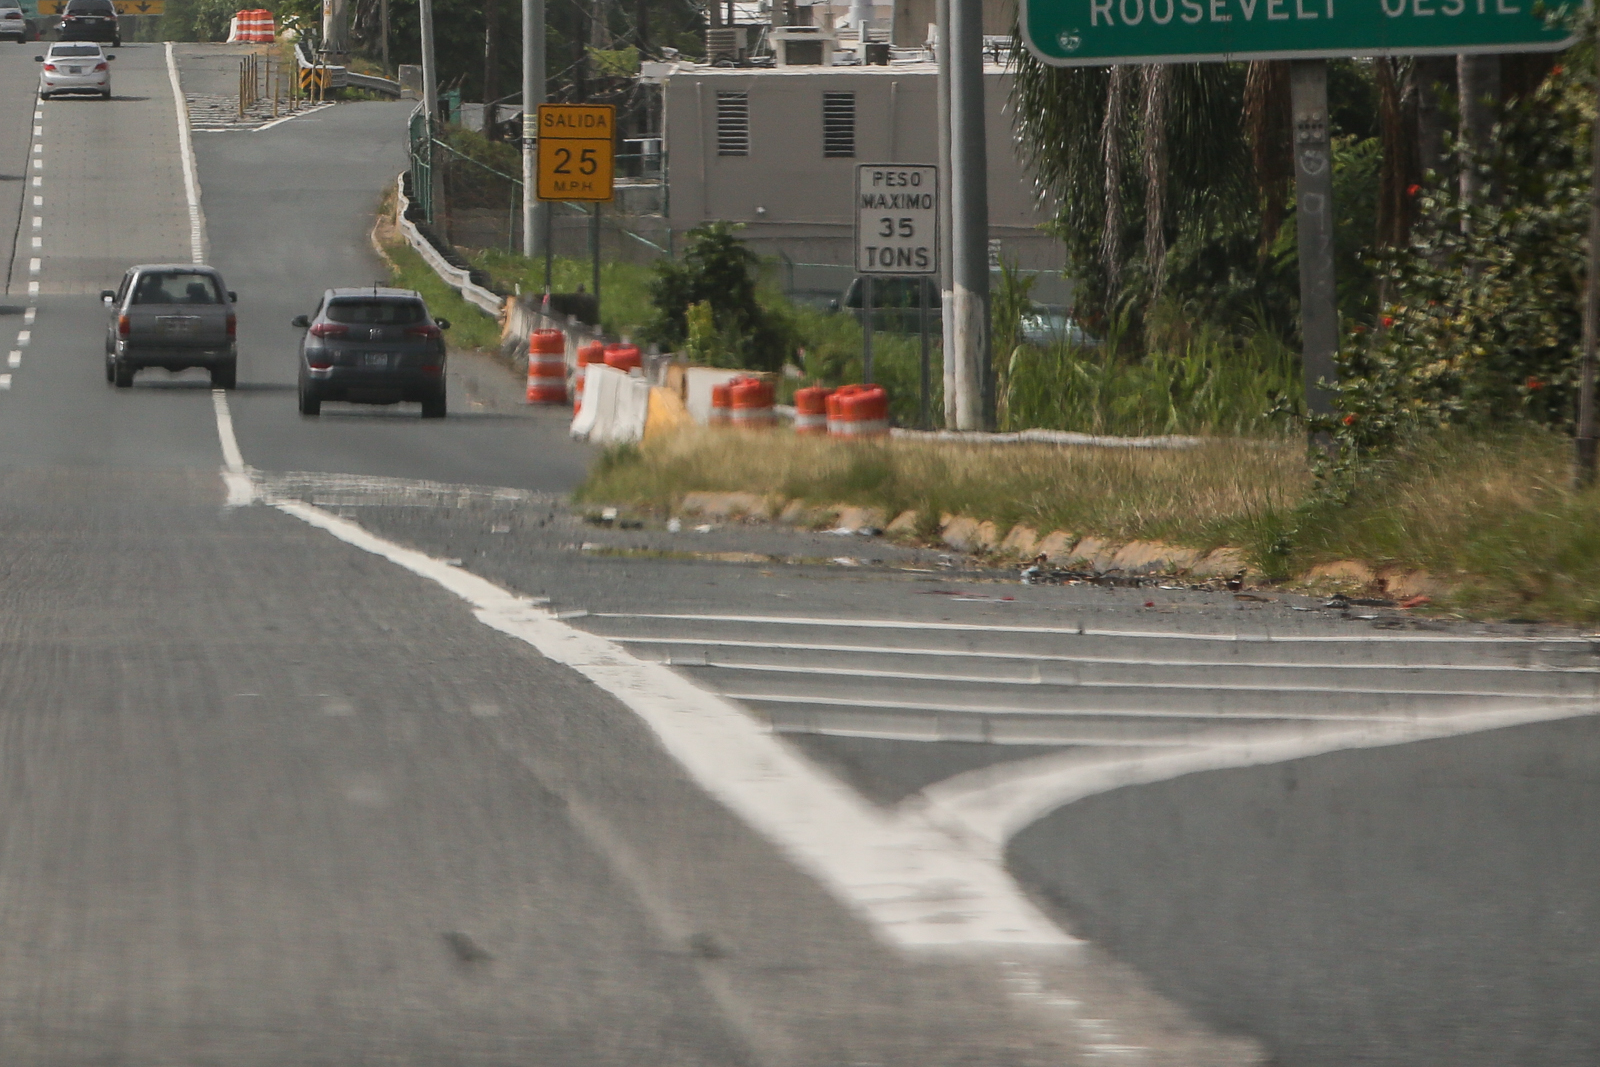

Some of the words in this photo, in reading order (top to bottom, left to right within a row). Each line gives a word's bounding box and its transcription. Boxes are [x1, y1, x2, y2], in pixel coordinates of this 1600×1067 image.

[544, 113, 607, 128] SALIDA
[553, 147, 597, 175] 25
[872, 171, 921, 186] PESO
[861, 193, 932, 209] MAXIMO
[878, 217, 914, 238] 35
[865, 246, 929, 267] TONS
